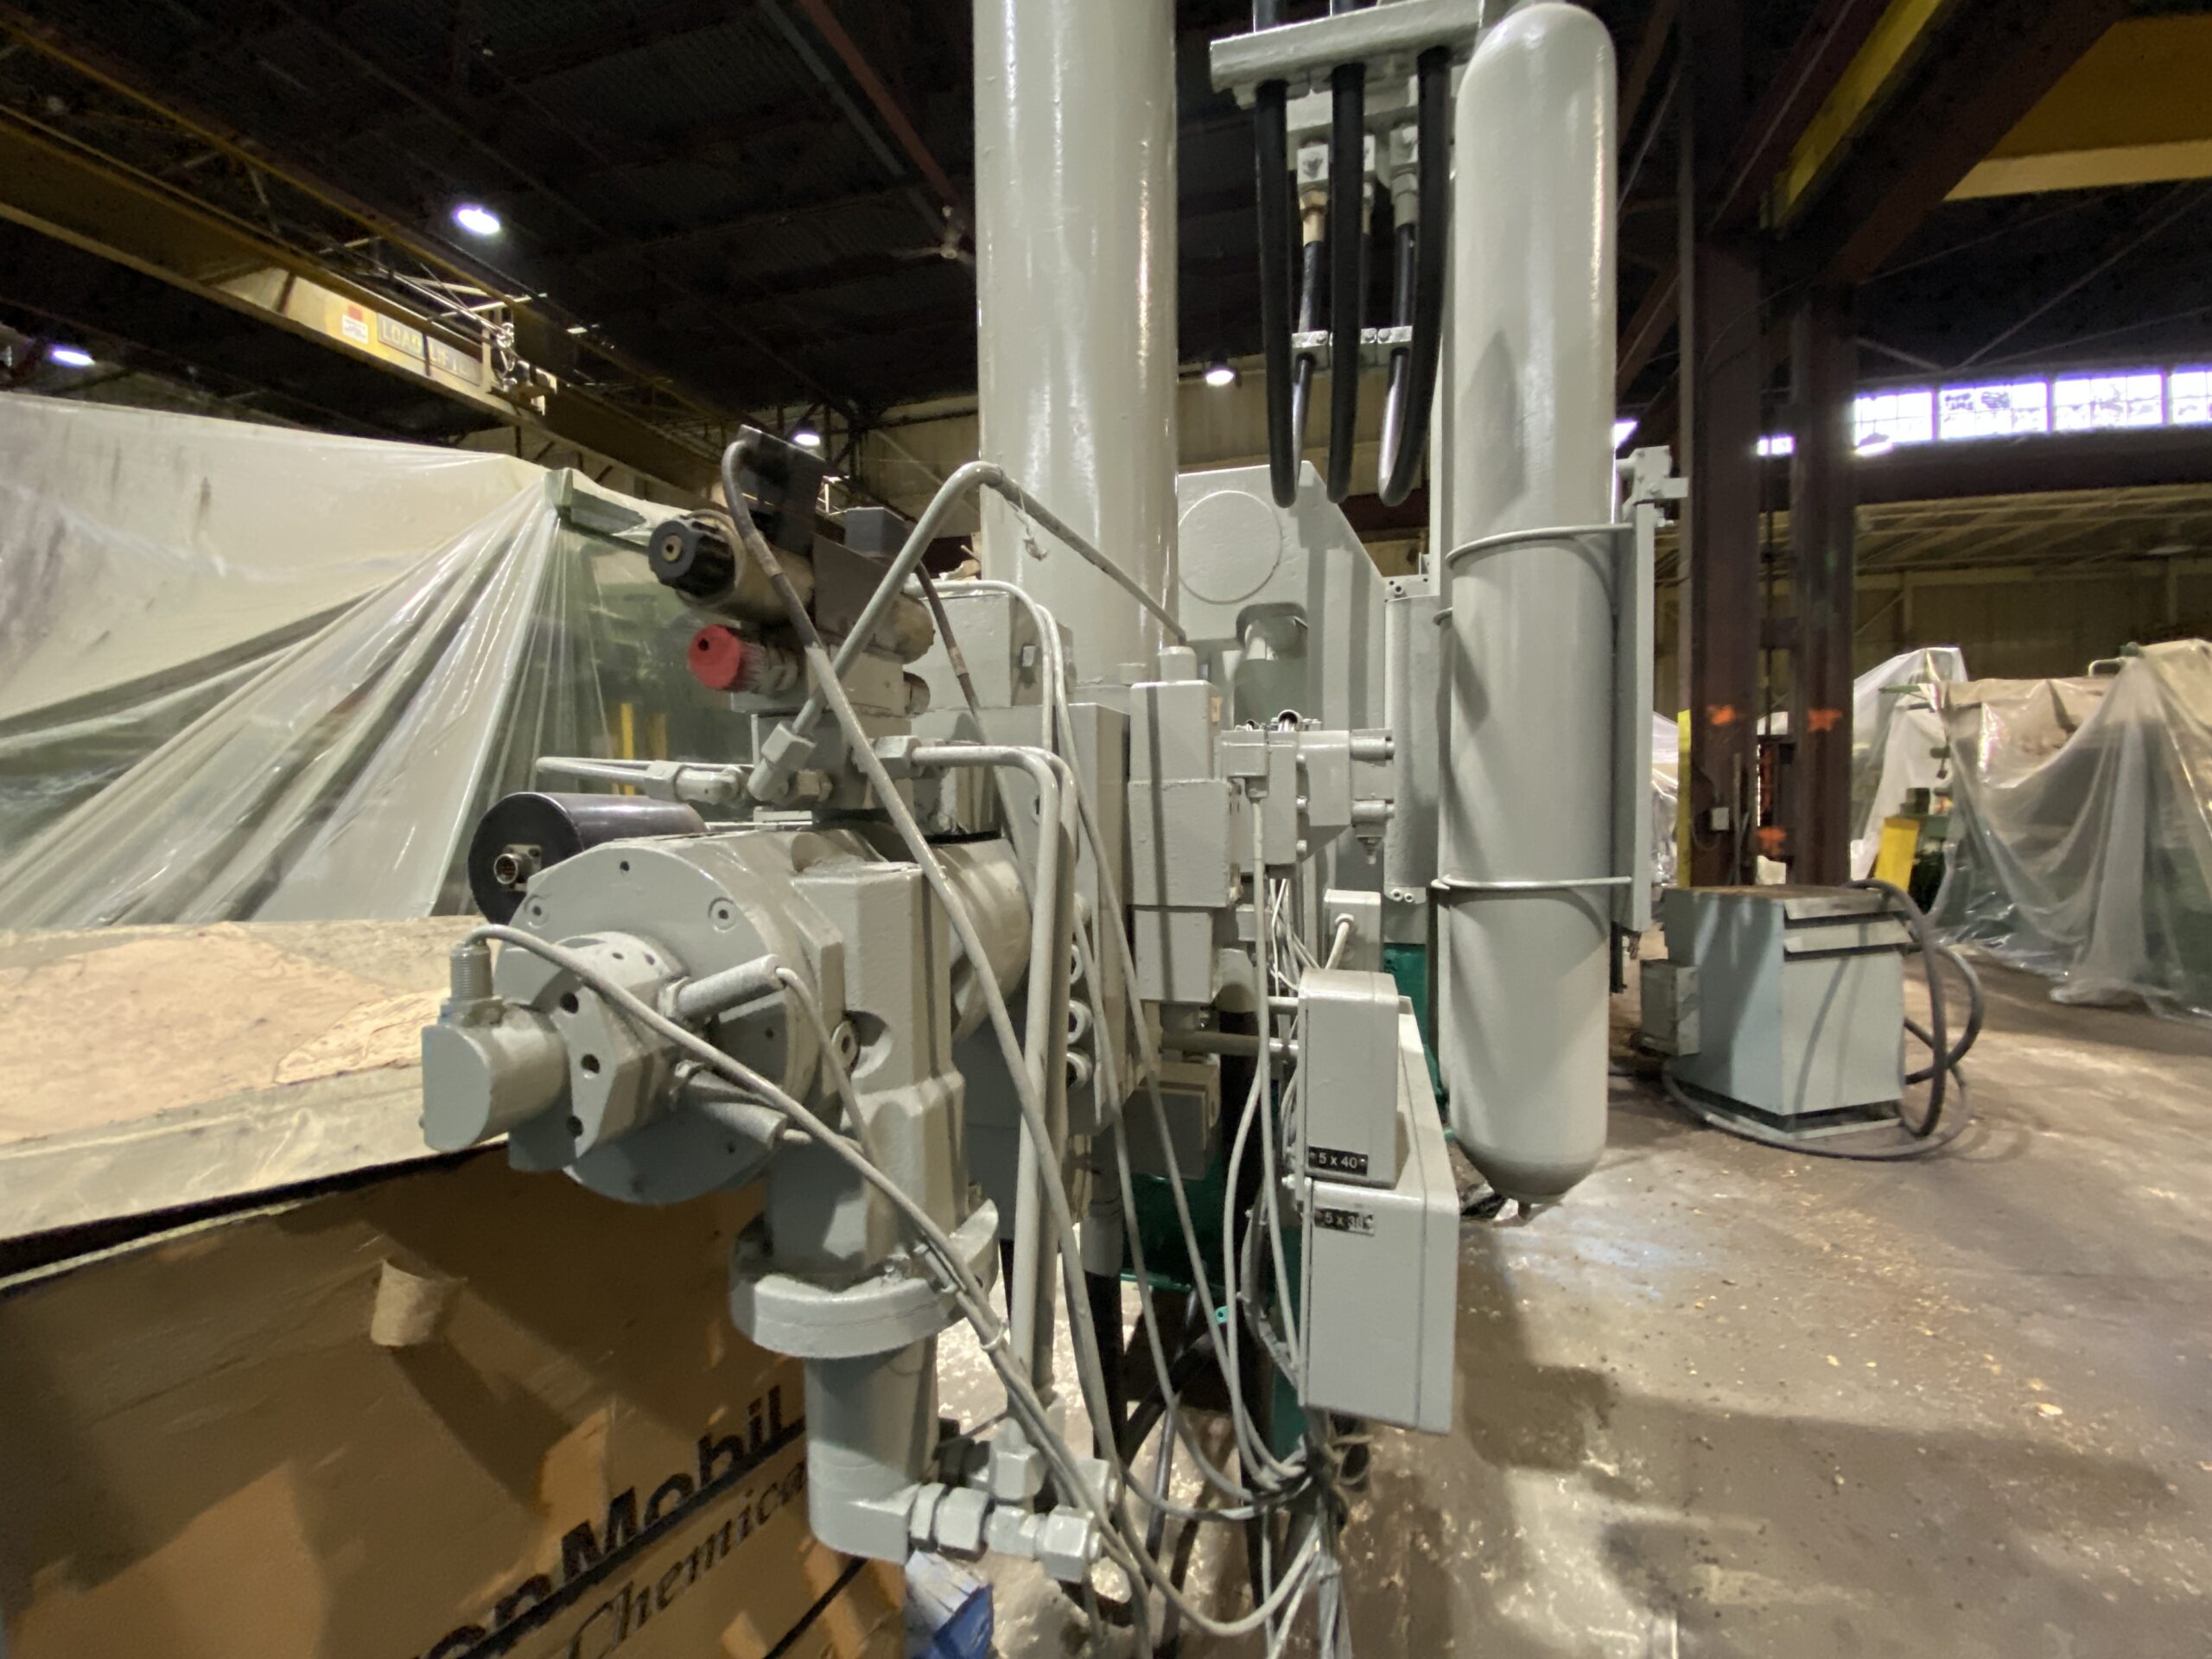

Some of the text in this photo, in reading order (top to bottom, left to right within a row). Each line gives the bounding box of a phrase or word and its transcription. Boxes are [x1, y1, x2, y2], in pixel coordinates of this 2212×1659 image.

[382, 318, 422, 353] LOAD
[1319, 1152, 1327, 1165] 5
[1340, 1156, 1358, 1169] 40
[1325, 1211, 1334, 1224] 5
[564, 1459, 807, 1659] Chemica
